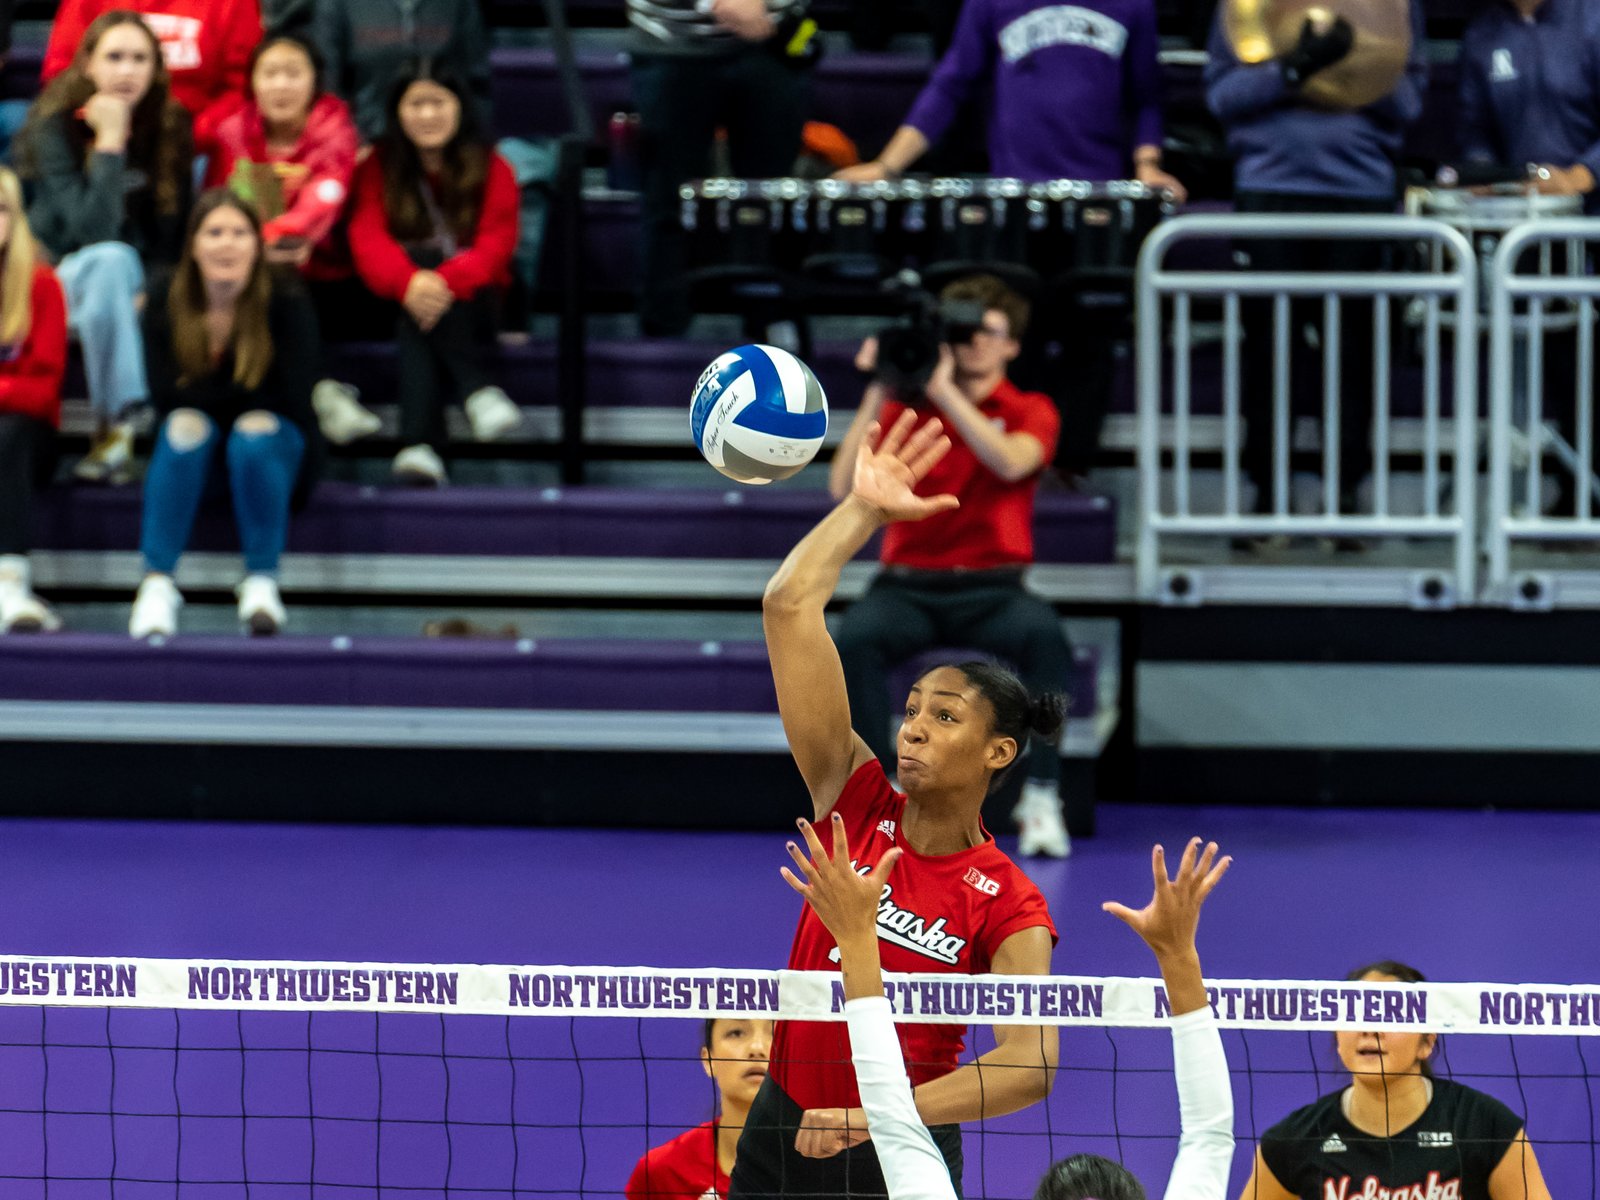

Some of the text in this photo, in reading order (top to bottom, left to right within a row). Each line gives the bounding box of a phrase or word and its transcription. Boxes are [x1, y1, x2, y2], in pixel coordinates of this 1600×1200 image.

[717, 390, 739, 425] Touch
[188, 966, 459, 1006] NORTHWESTERN
[508, 973, 780, 1012] NORTHWESTERN
[831, 980, 1104, 1018] NRTHWESTERN
[1154, 985, 1428, 1023] NRTHWESTERN
